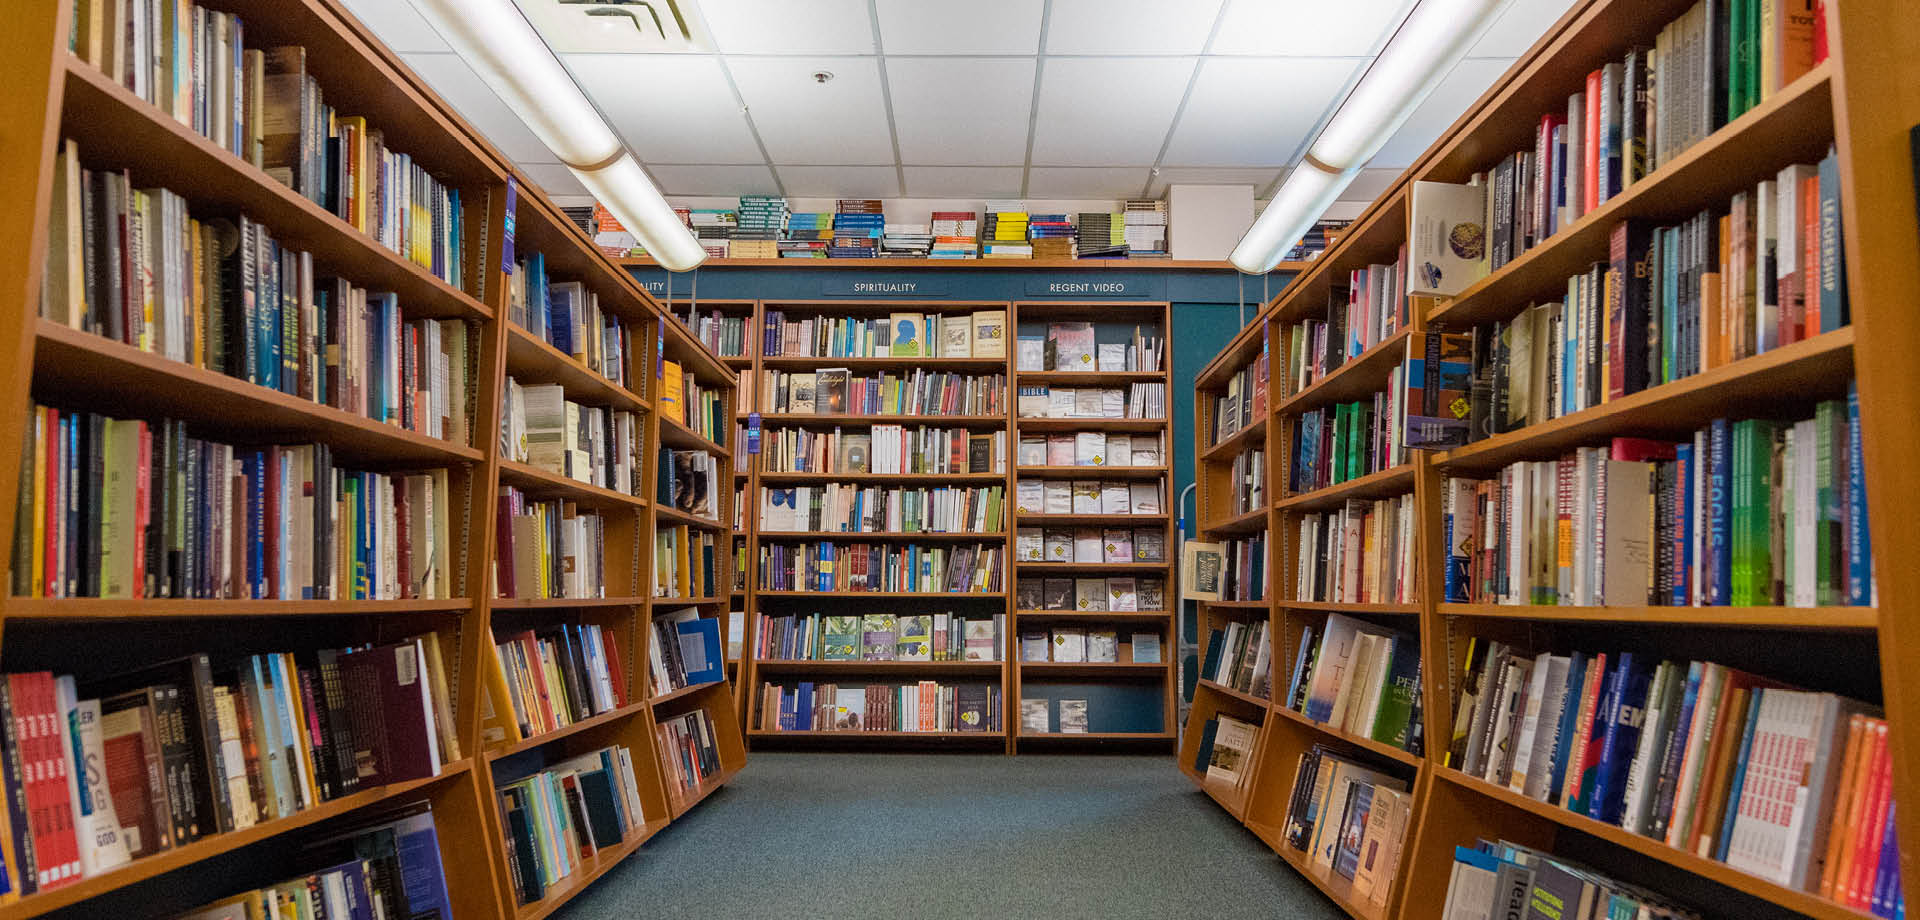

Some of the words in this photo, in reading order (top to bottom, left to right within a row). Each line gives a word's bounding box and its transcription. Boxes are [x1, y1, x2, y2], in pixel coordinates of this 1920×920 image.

[1822, 199, 1835, 291] LEADERSHIP
[854, 283, 916, 292] SPIRITUALITY
[1050, 283, 1089, 292] REGENT
[1092, 283, 1125, 292] VIDEO
[1023, 388, 1045, 396] BIBLE
[187, 449, 195, 483] Where
[1851, 417, 1860, 485] IMMUNITY
[1711, 475, 1723, 546] FOCUS
[1851, 506, 1861, 565] CHANGE
